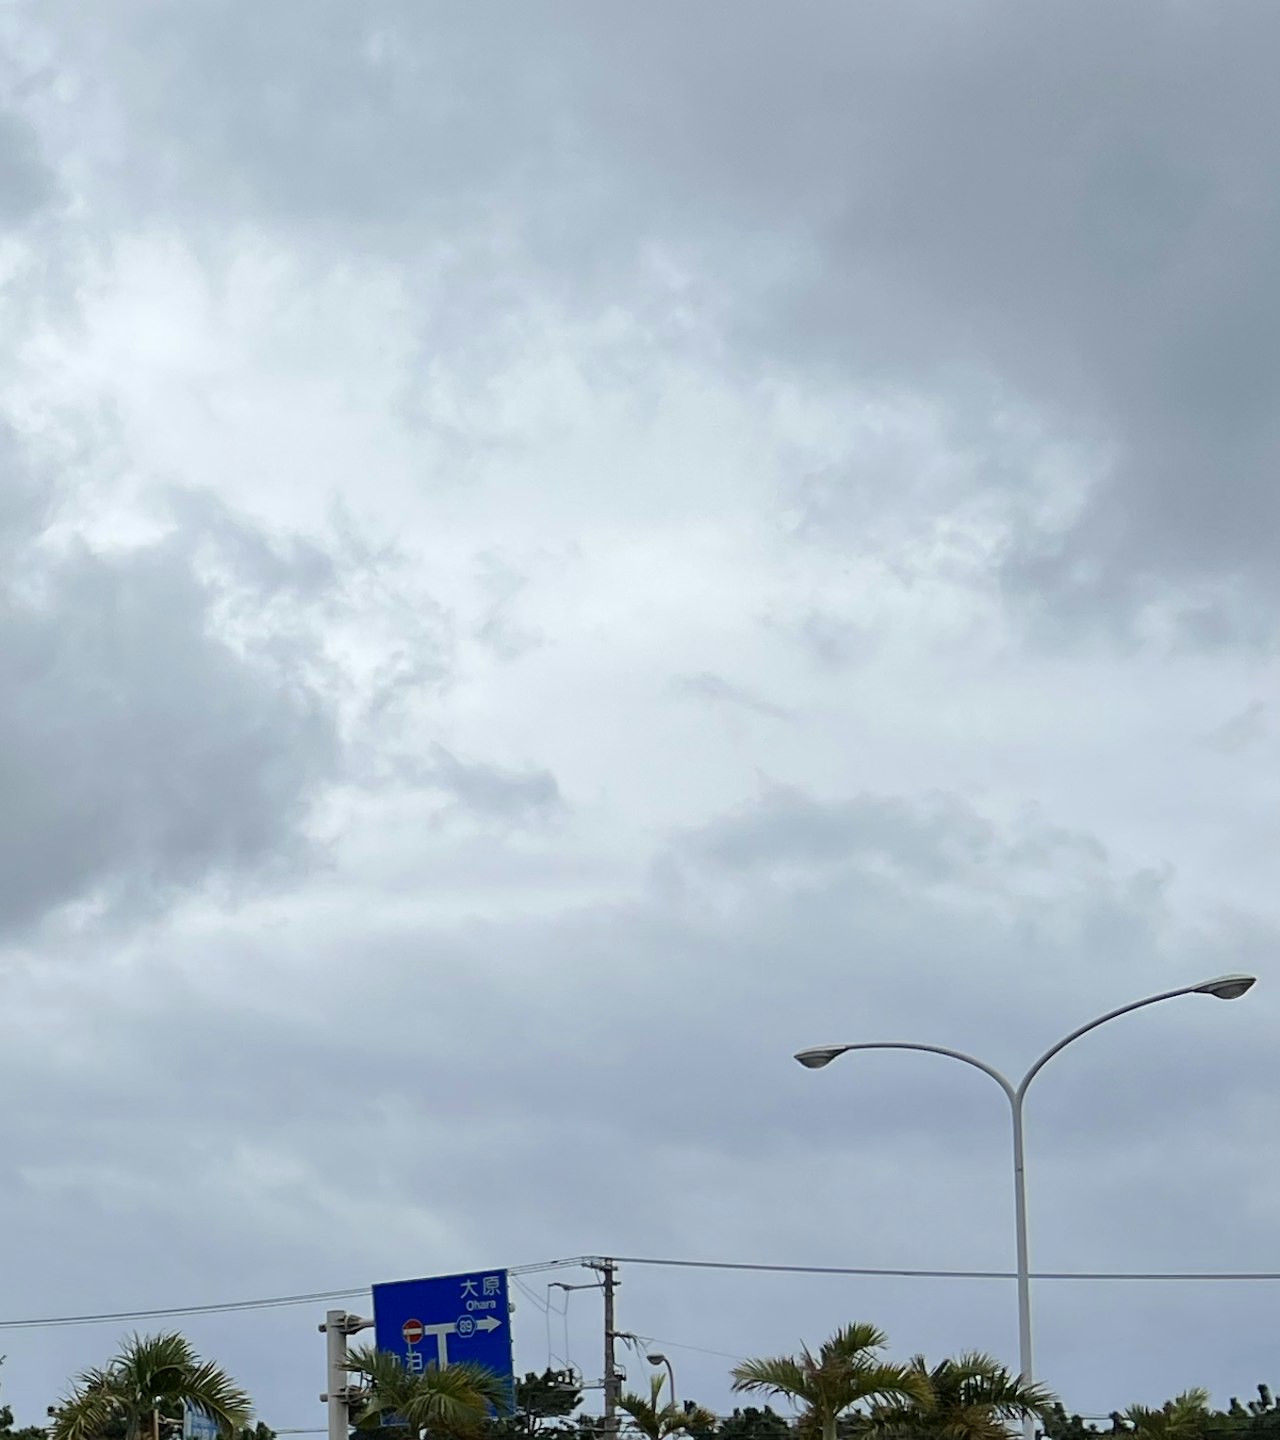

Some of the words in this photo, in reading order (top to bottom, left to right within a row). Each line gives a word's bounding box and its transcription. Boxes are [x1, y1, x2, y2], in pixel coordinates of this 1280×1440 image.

[460, 1276, 501, 1299] 大原
[466, 1299, 496, 1311] Ohara
[459, 1319, 473, 1334] 89
